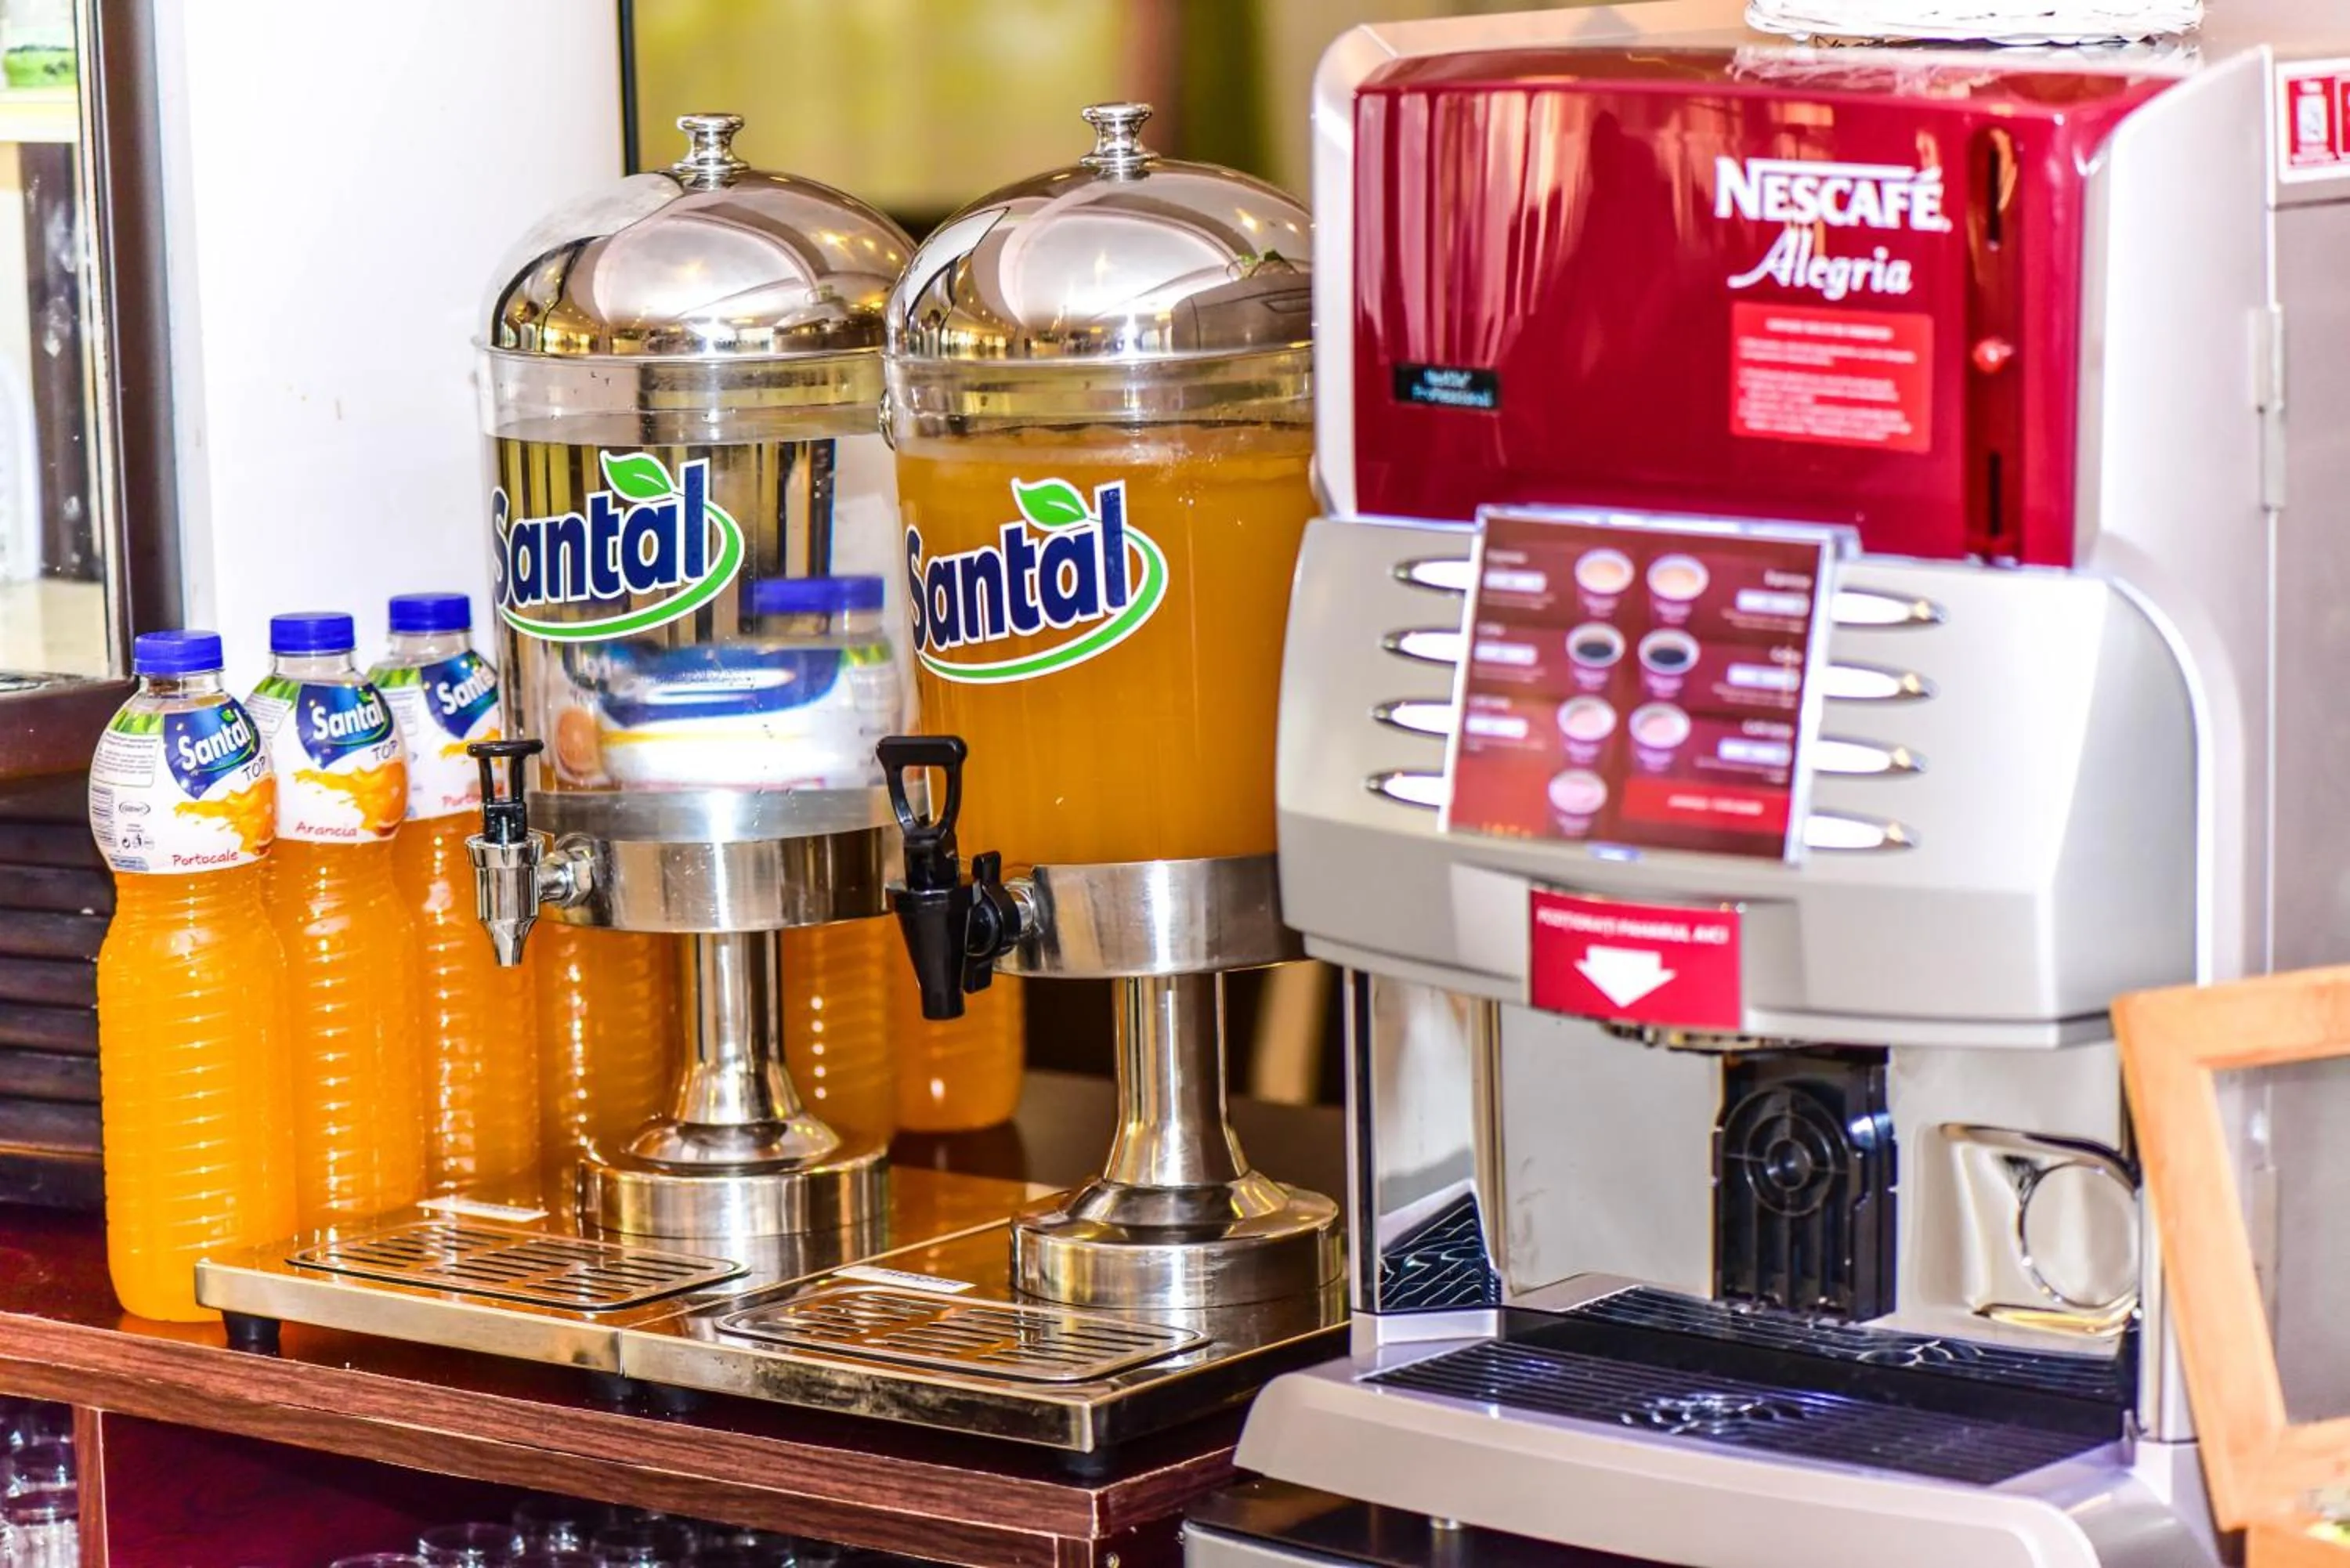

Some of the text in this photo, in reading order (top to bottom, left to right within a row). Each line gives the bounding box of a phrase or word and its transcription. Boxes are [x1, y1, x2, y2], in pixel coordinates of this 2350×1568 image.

[1715, 157, 1949, 232] NESCAFÉ
[1727, 227, 1912, 301] Alegria
[491, 457, 710, 609] Santal
[906, 479, 1127, 652] Santal
[177, 706, 251, 771] Santal
[311, 692, 385, 740] Santal
[241, 756, 266, 782] TOP
[371, 740, 398, 761] TOP
[172, 848, 238, 866] Portocale
[295, 822, 358, 837] Arancia
